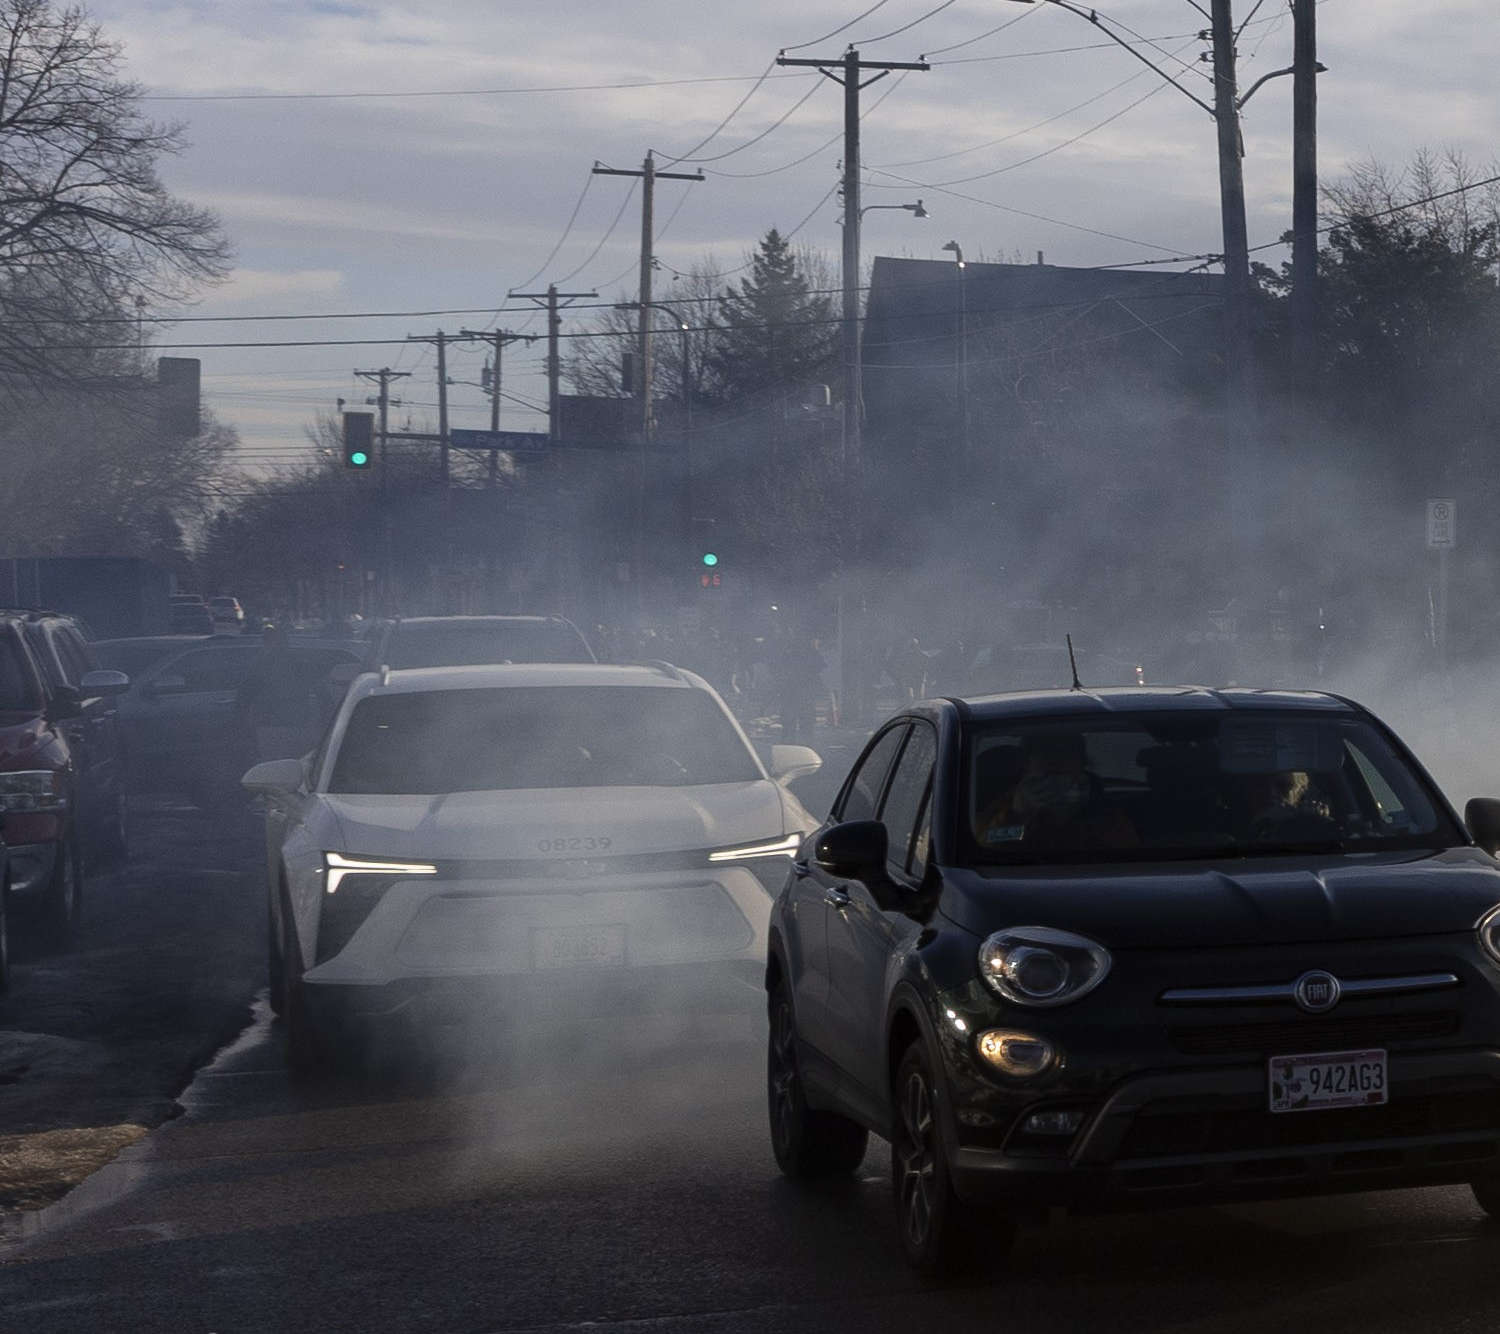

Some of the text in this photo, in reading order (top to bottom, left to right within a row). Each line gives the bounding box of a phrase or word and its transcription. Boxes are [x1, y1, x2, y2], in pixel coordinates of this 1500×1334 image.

[476, 434, 515, 447] Park
[538, 837, 611, 852] 08239
[1306, 983, 1328, 1000] FIAT
[1309, 1063, 1384, 1094] 942AG3
